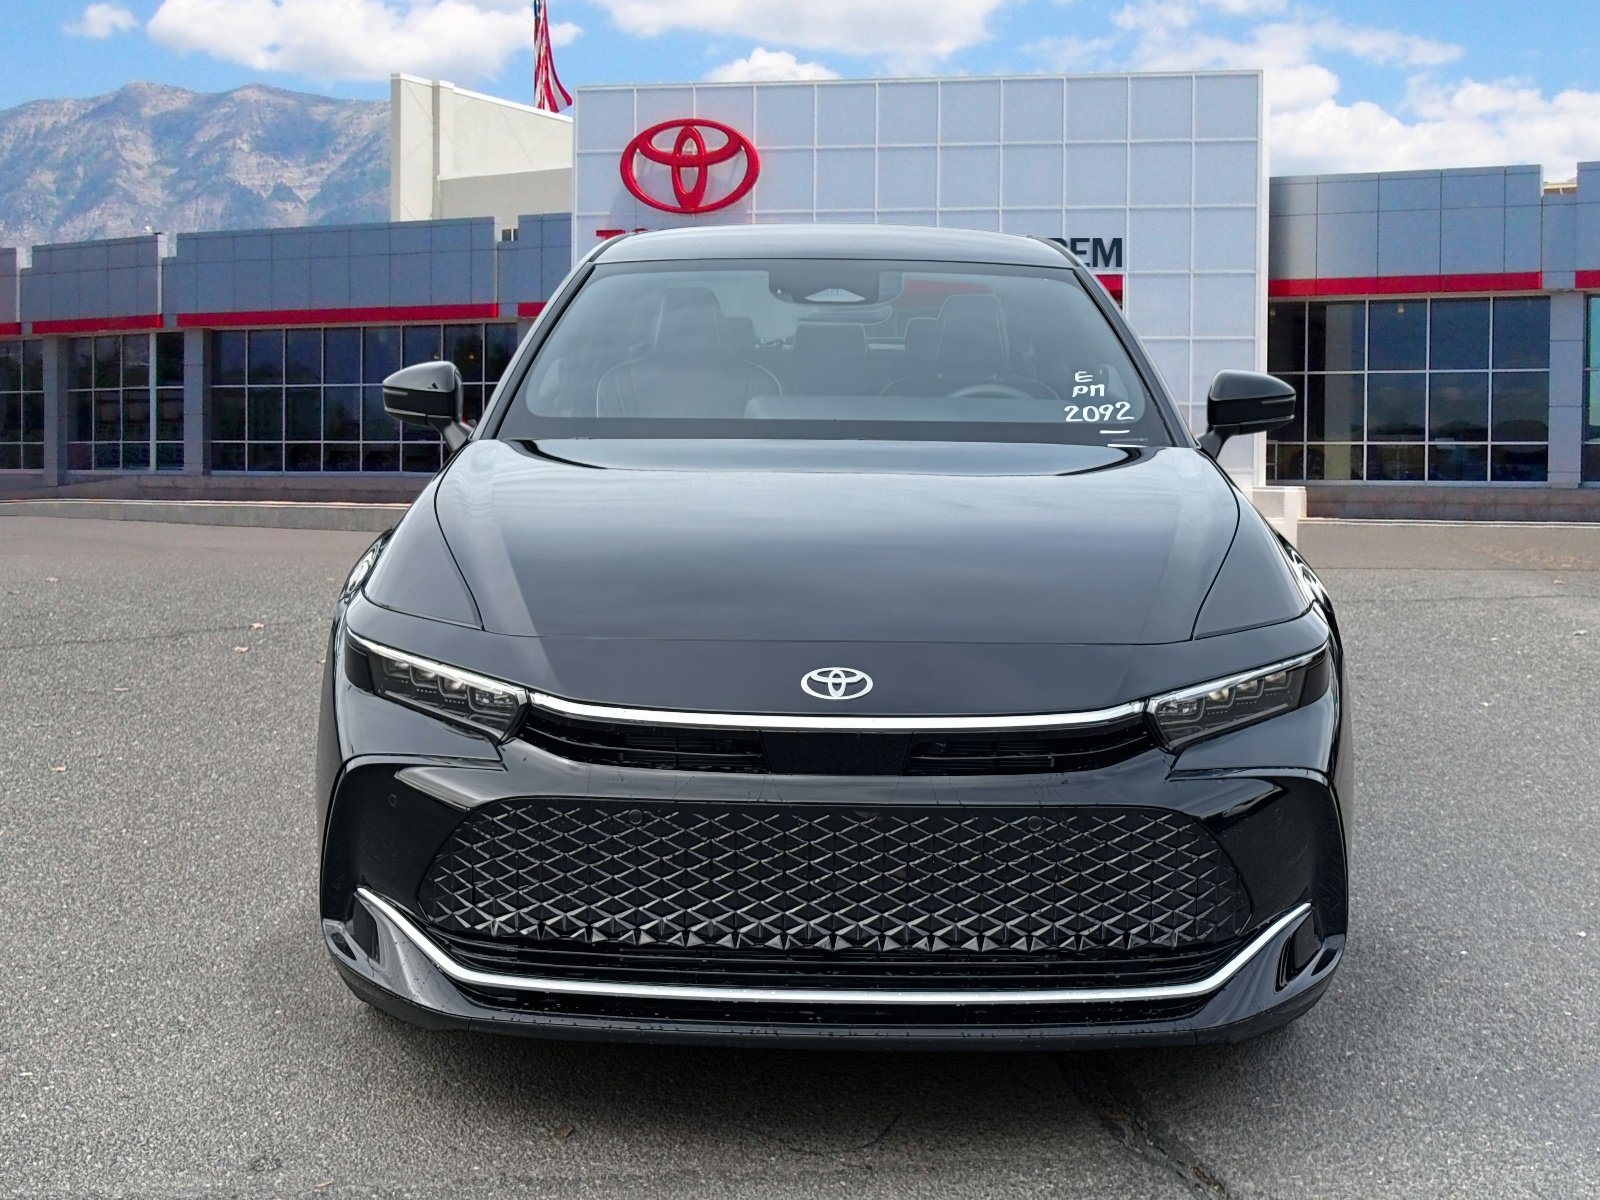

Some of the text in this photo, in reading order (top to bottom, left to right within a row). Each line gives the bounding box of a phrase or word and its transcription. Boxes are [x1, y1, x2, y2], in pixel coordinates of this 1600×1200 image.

[1046, 237, 1123, 268] EM
[1074, 371, 1094, 383] E
[1063, 401, 1135, 422] 2092
